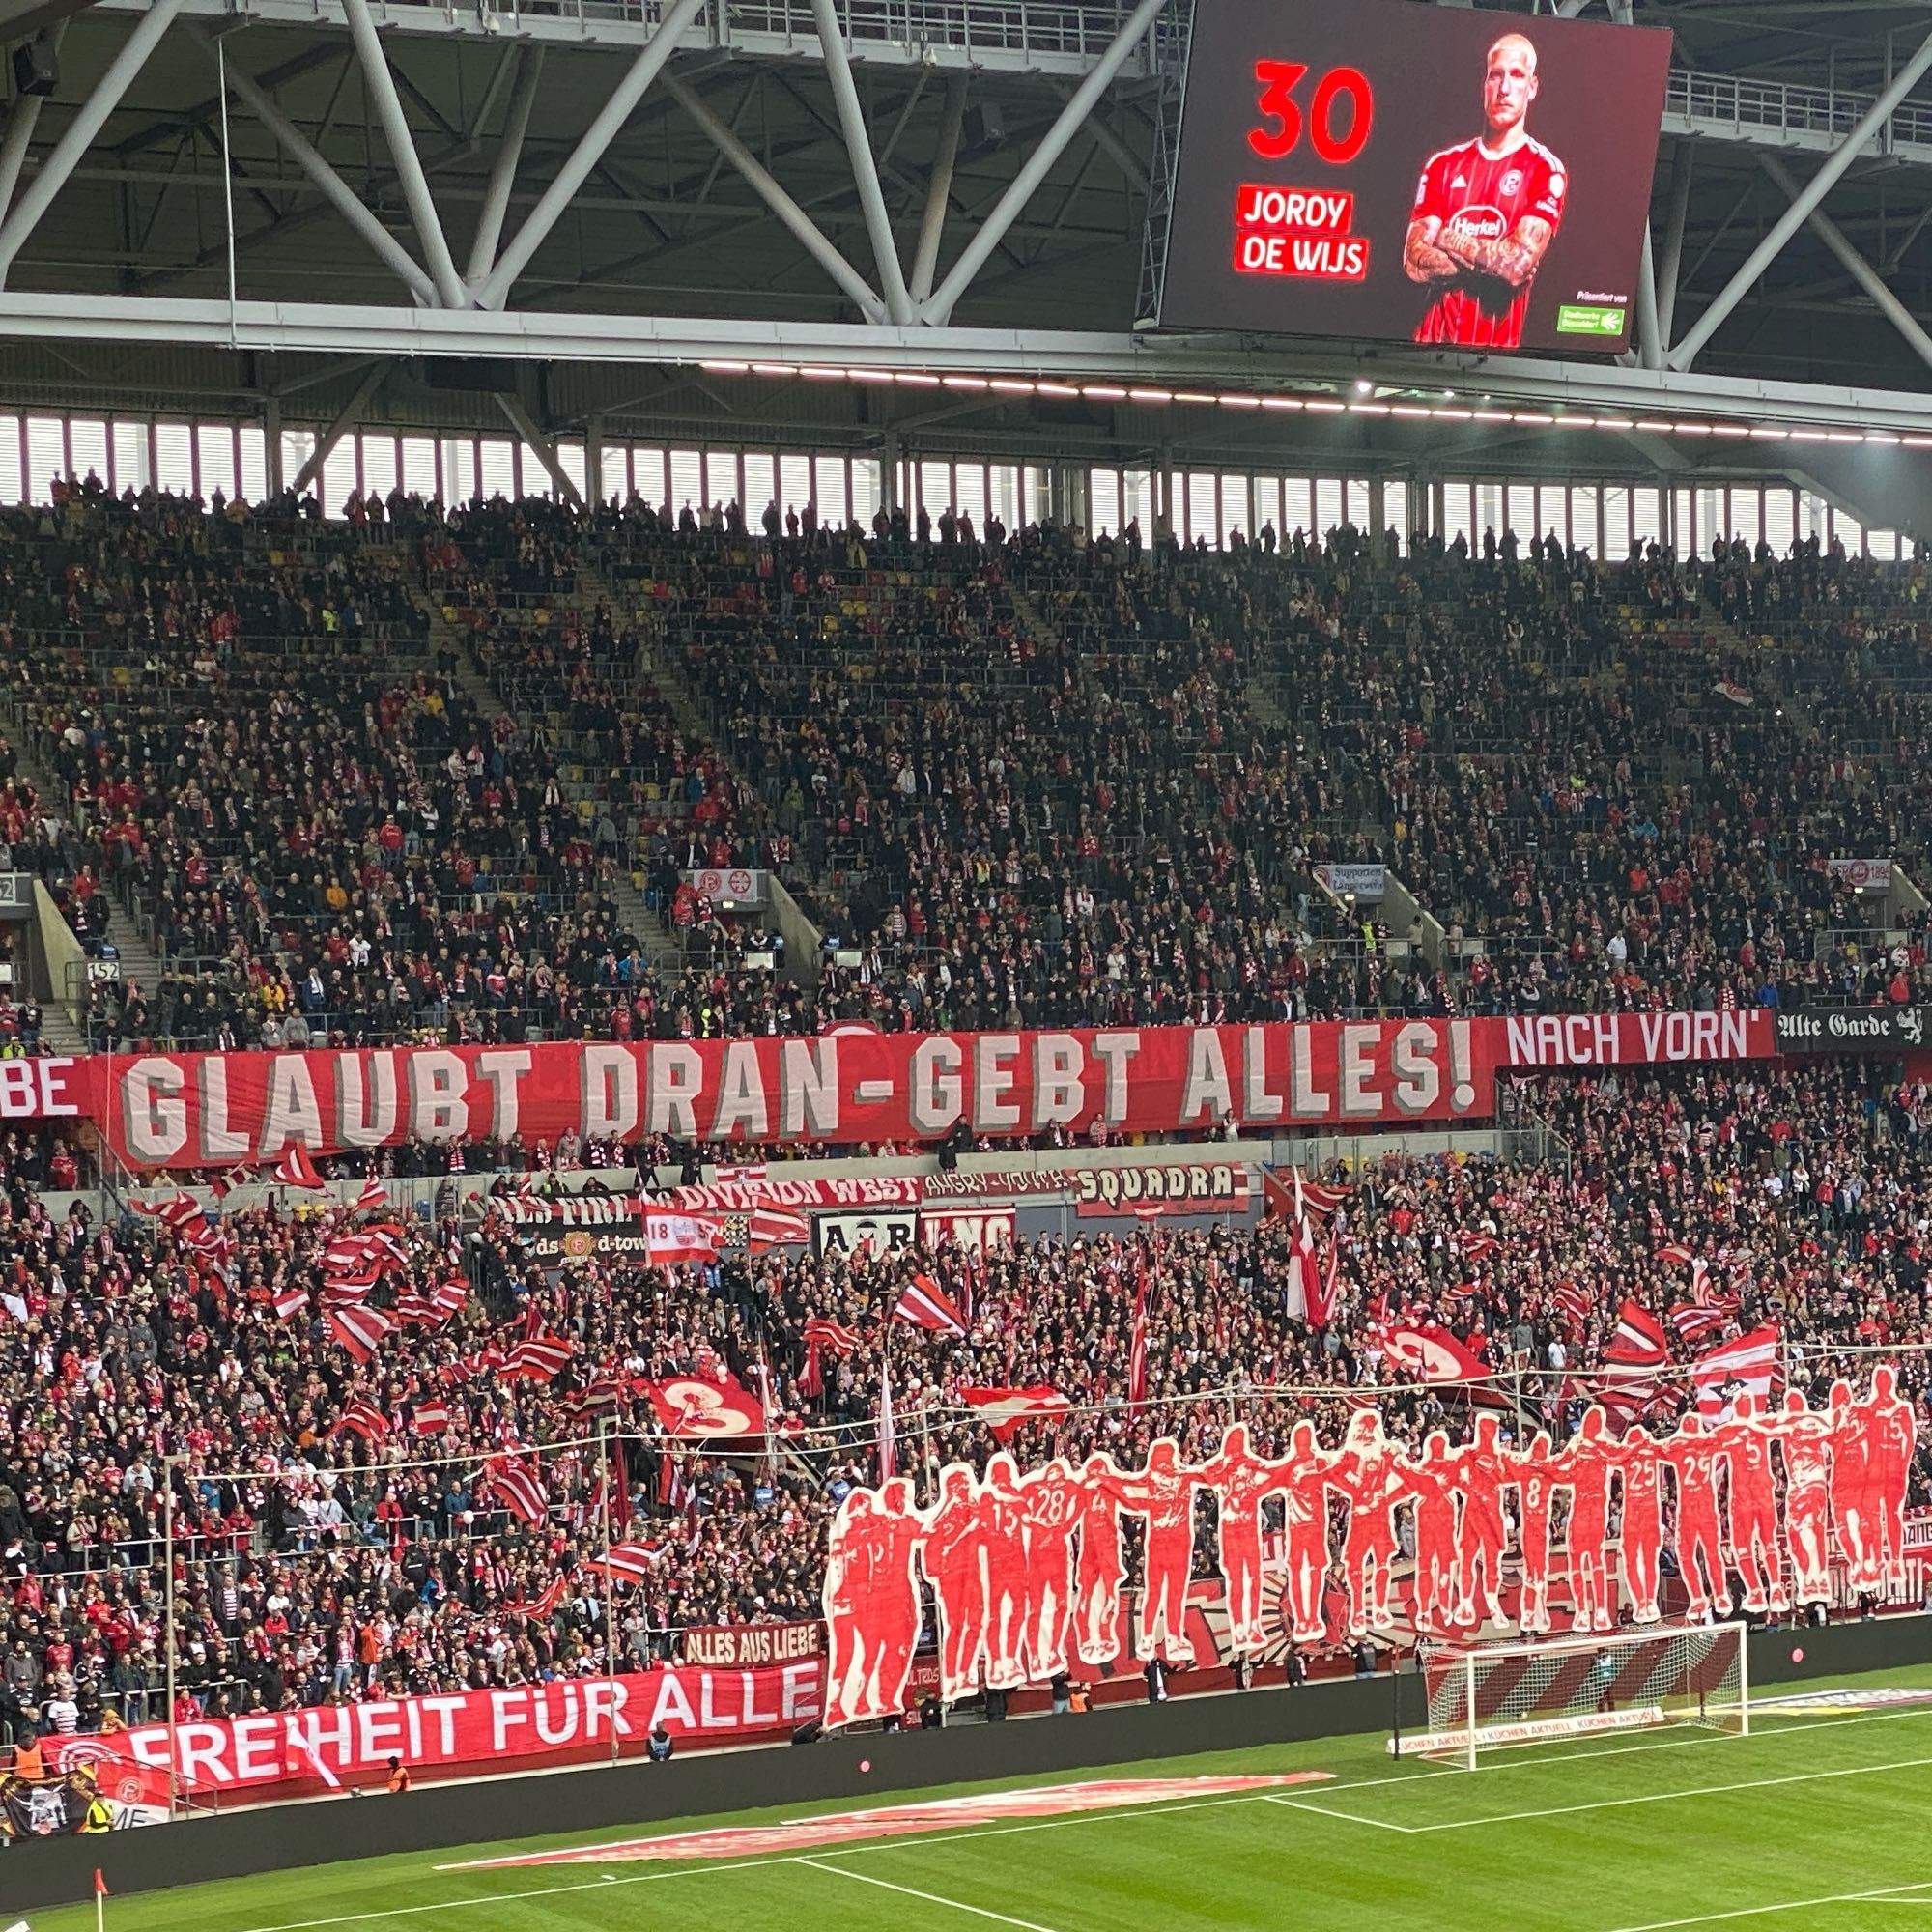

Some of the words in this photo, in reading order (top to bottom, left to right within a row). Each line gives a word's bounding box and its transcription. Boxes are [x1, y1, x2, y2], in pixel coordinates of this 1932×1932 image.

[1247, 60, 1374, 164] 30
[1243, 190, 1348, 229] JORDY
[1242, 238, 1285, 270] DE
[1292, 242, 1363, 275] WIJS
[90, 964, 118, 979] 152
[1506, 1012, 1621, 1065] NACH
[1644, 1009, 1760, 1062] VORN'
[1777, 1014, 1823, 1037] Alte
[1828, 1014, 1891, 1037] Garde
[122, 1049, 532, 1161] GLAUBT
[580, 1036, 840, 1146] DRAN
[908, 1031, 1141, 1130] GEBT
[1180, 1018, 1477, 1126] ALLES!
[828, 1175, 918, 1203] WEST
[1077, 1165, 1232, 1206] SQUADRA
[1037, 1488, 1065, 1525] 28
[1527, 1478, 1541, 1509] 8
[686, 1632, 736, 1664] ALLES
[739, 1631, 770, 1662] AUS
[773, 1623, 819, 1660] LIEBE
[491, 1681, 633, 1750] FÜR
[649, 1661, 821, 1732] ALLE
[1397, 1739, 1435, 1750] ÜCHEN
